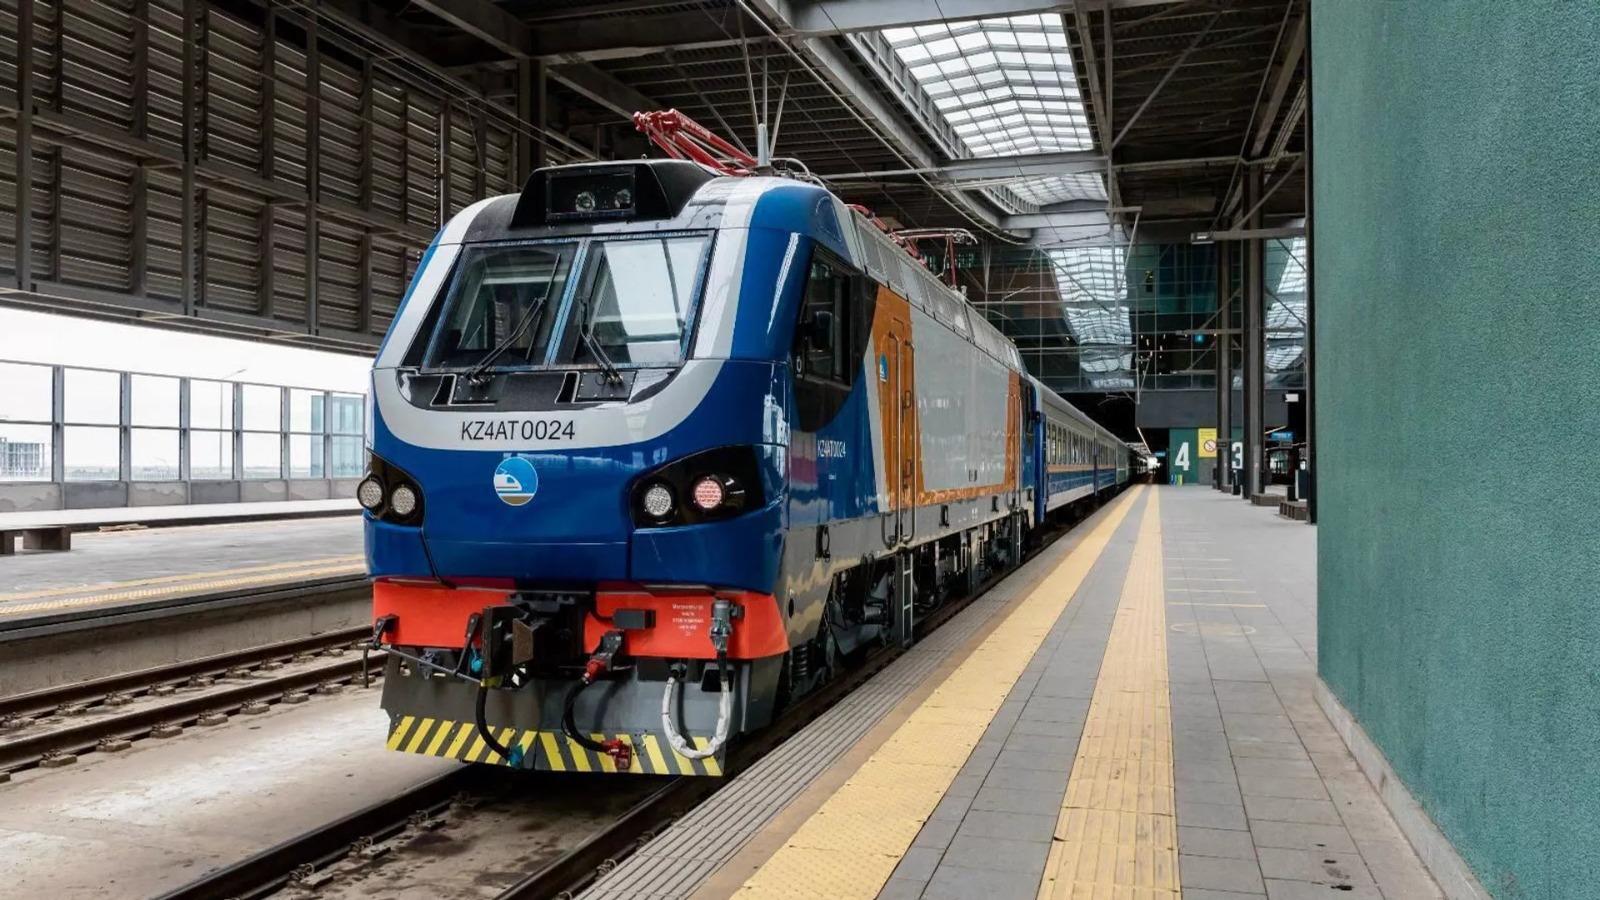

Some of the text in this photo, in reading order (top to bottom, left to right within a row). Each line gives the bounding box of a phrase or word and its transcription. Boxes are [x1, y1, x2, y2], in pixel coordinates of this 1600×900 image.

[461, 420, 575, 440] KZ4AT0024
[1175, 442, 1190, 471] 4
[1232, 442, 1243, 469] 3
